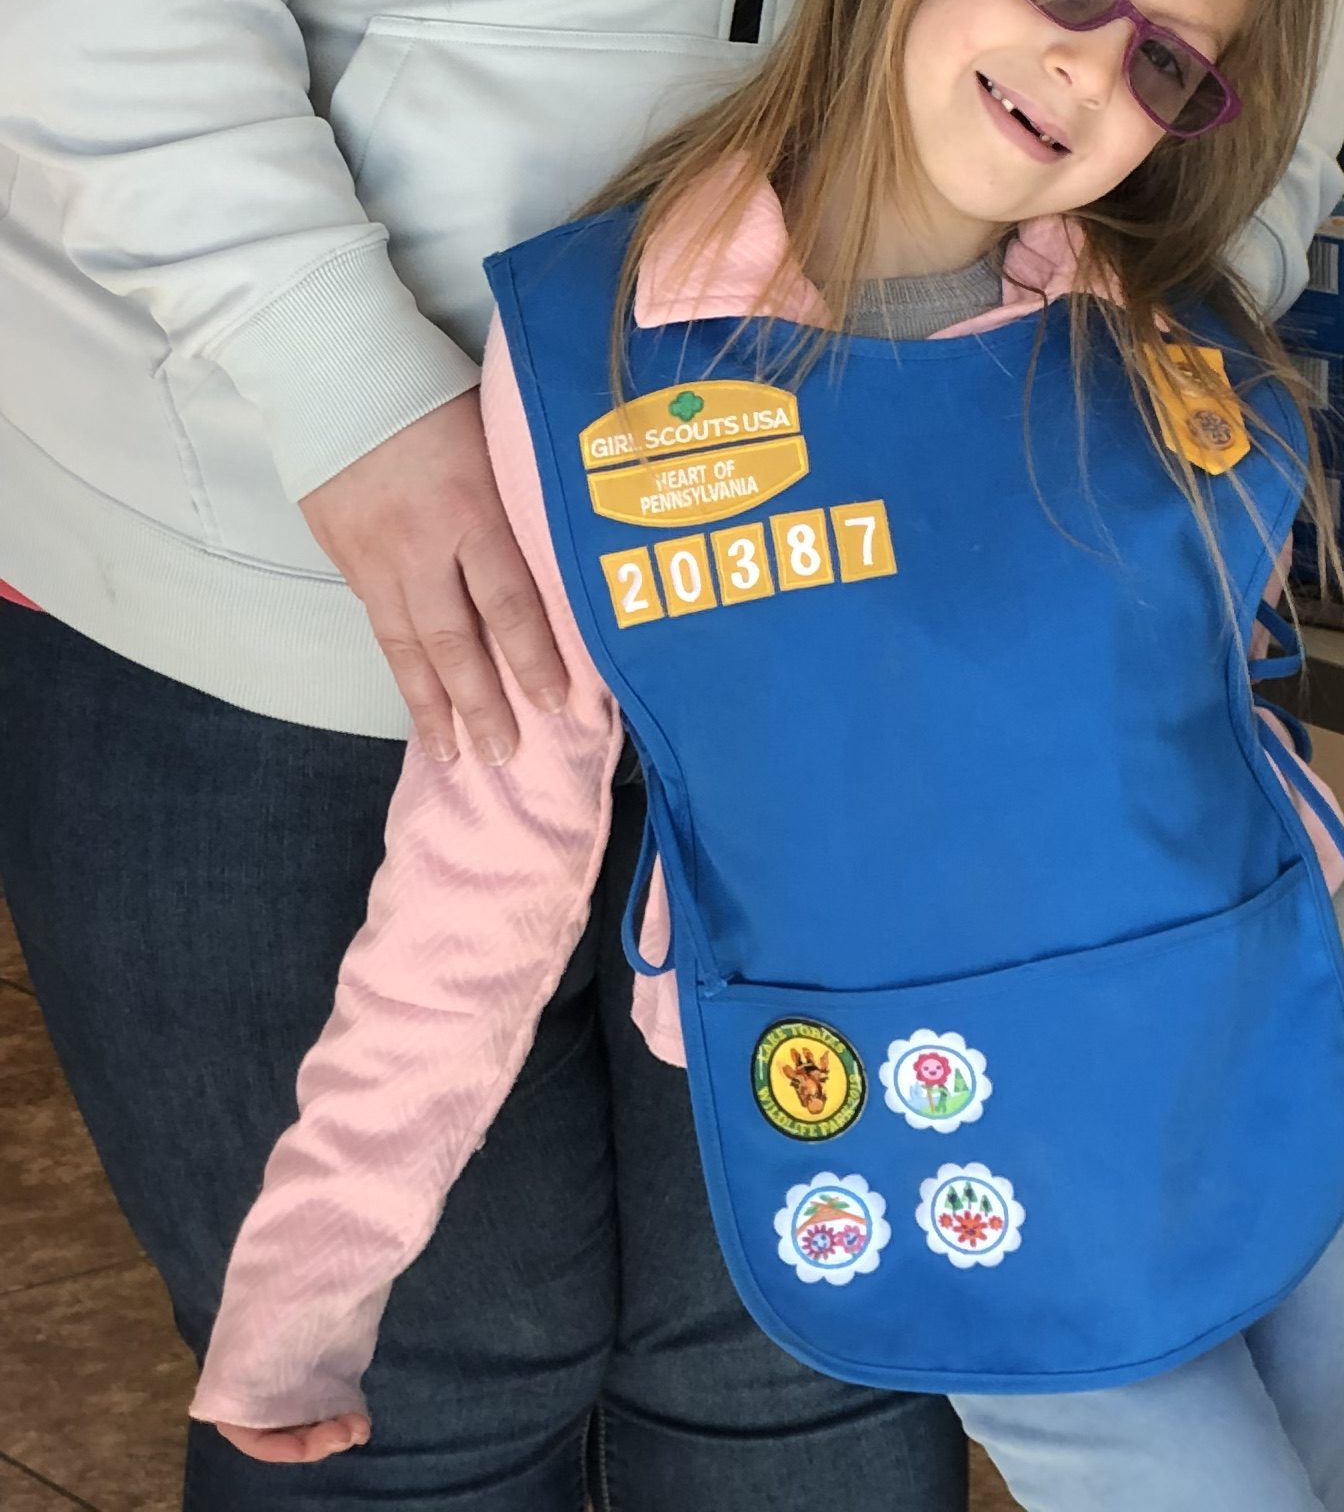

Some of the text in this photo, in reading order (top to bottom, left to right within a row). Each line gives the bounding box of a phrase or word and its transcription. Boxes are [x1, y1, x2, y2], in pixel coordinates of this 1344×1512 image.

[645, 407, 791, 449] SCOUTS USA
[656, 459, 736, 489] HEART OF
[640, 476, 759, 516] PENNSYLVANIA
